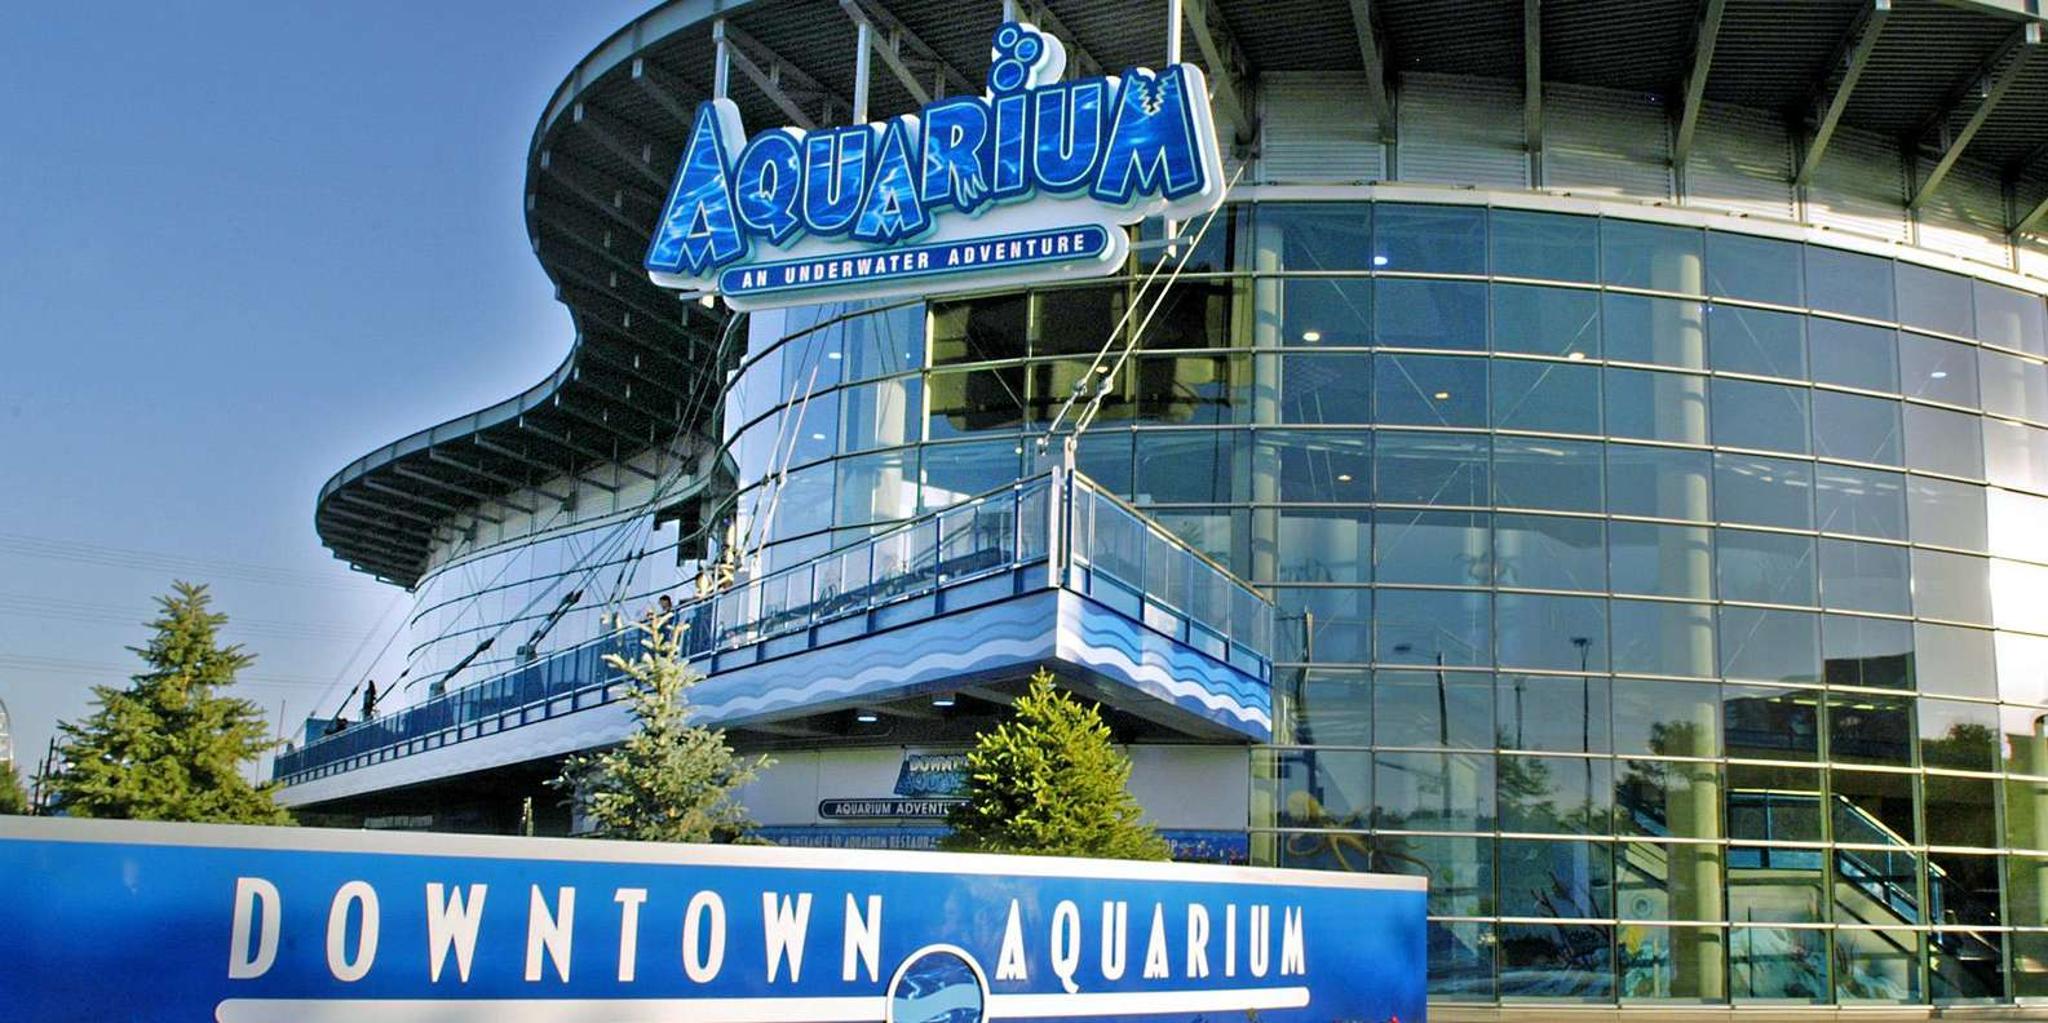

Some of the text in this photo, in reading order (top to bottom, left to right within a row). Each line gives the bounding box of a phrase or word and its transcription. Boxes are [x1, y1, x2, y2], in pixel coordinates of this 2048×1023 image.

[648, 24, 1206, 273] AQUARIUM
[741, 233, 1086, 288] AN UNDERWATER ADVENTURE
[834, 802, 950, 815] AQUARIUM ADVENTU
[227, 876, 1307, 994] DOWNTOWN AQUARIUM
